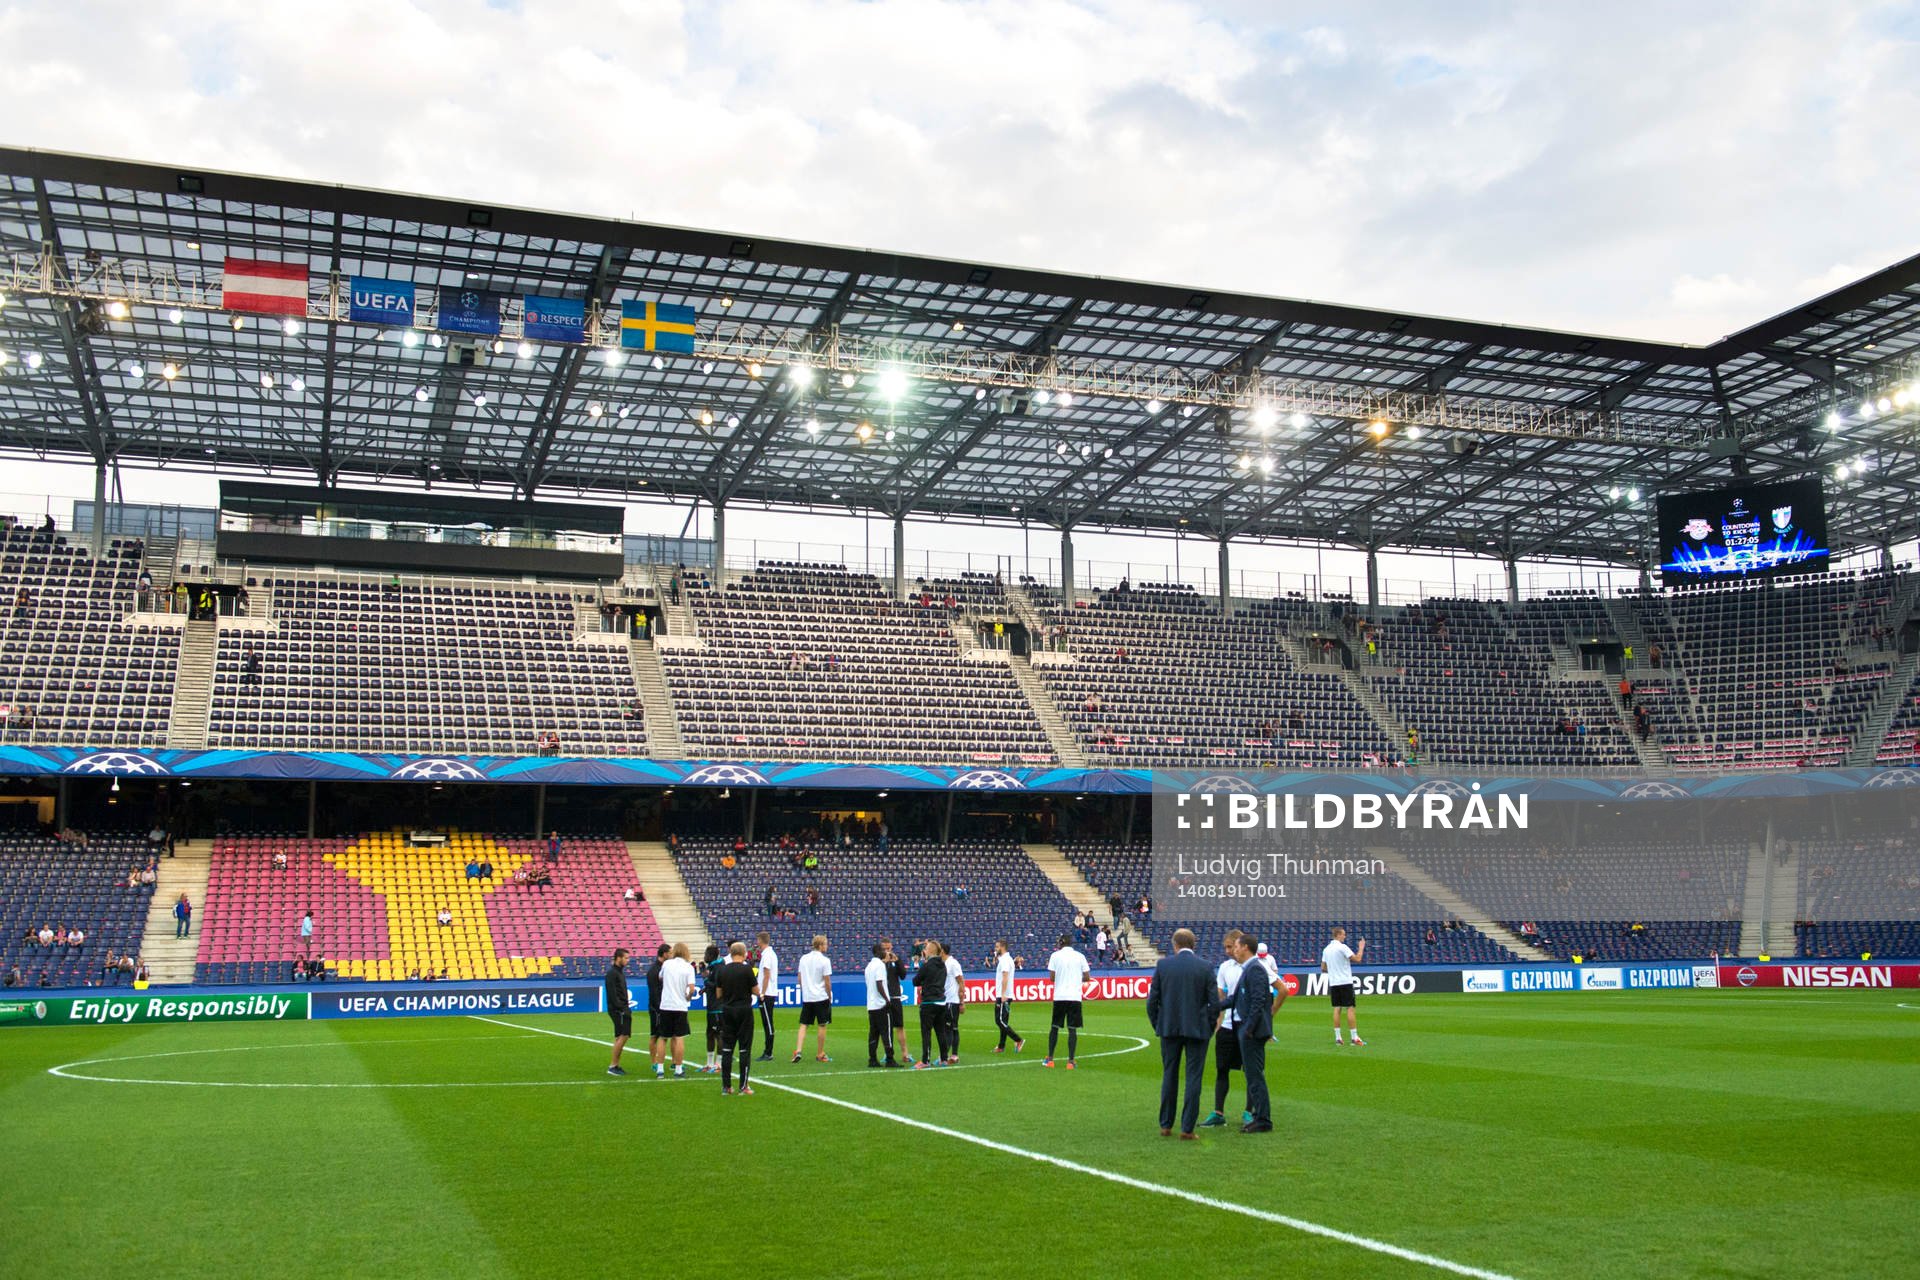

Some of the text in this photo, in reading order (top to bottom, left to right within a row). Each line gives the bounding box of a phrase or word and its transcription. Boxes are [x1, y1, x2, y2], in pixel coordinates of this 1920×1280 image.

[355, 291, 409, 312] UEFA
[541, 314, 583, 326] RESPECT
[1721, 522, 1760, 531] COUNTDOWN
[1725, 536, 1760, 546] 01:27:05
[1511, 971, 1574, 990] GAZPROM
[1629, 969, 1690, 987] GAZPROM
[1694, 970, 1715, 978] UEFA
[1783, 967, 1892, 987] NISSAN
[963, 981, 997, 1002] ank
[1306, 973, 1416, 996] Mestro
[70, 995, 291, 1023] Enjoy Responsibly
[339, 993, 574, 1012] UEFA CHAMPIONS LEAGUE
